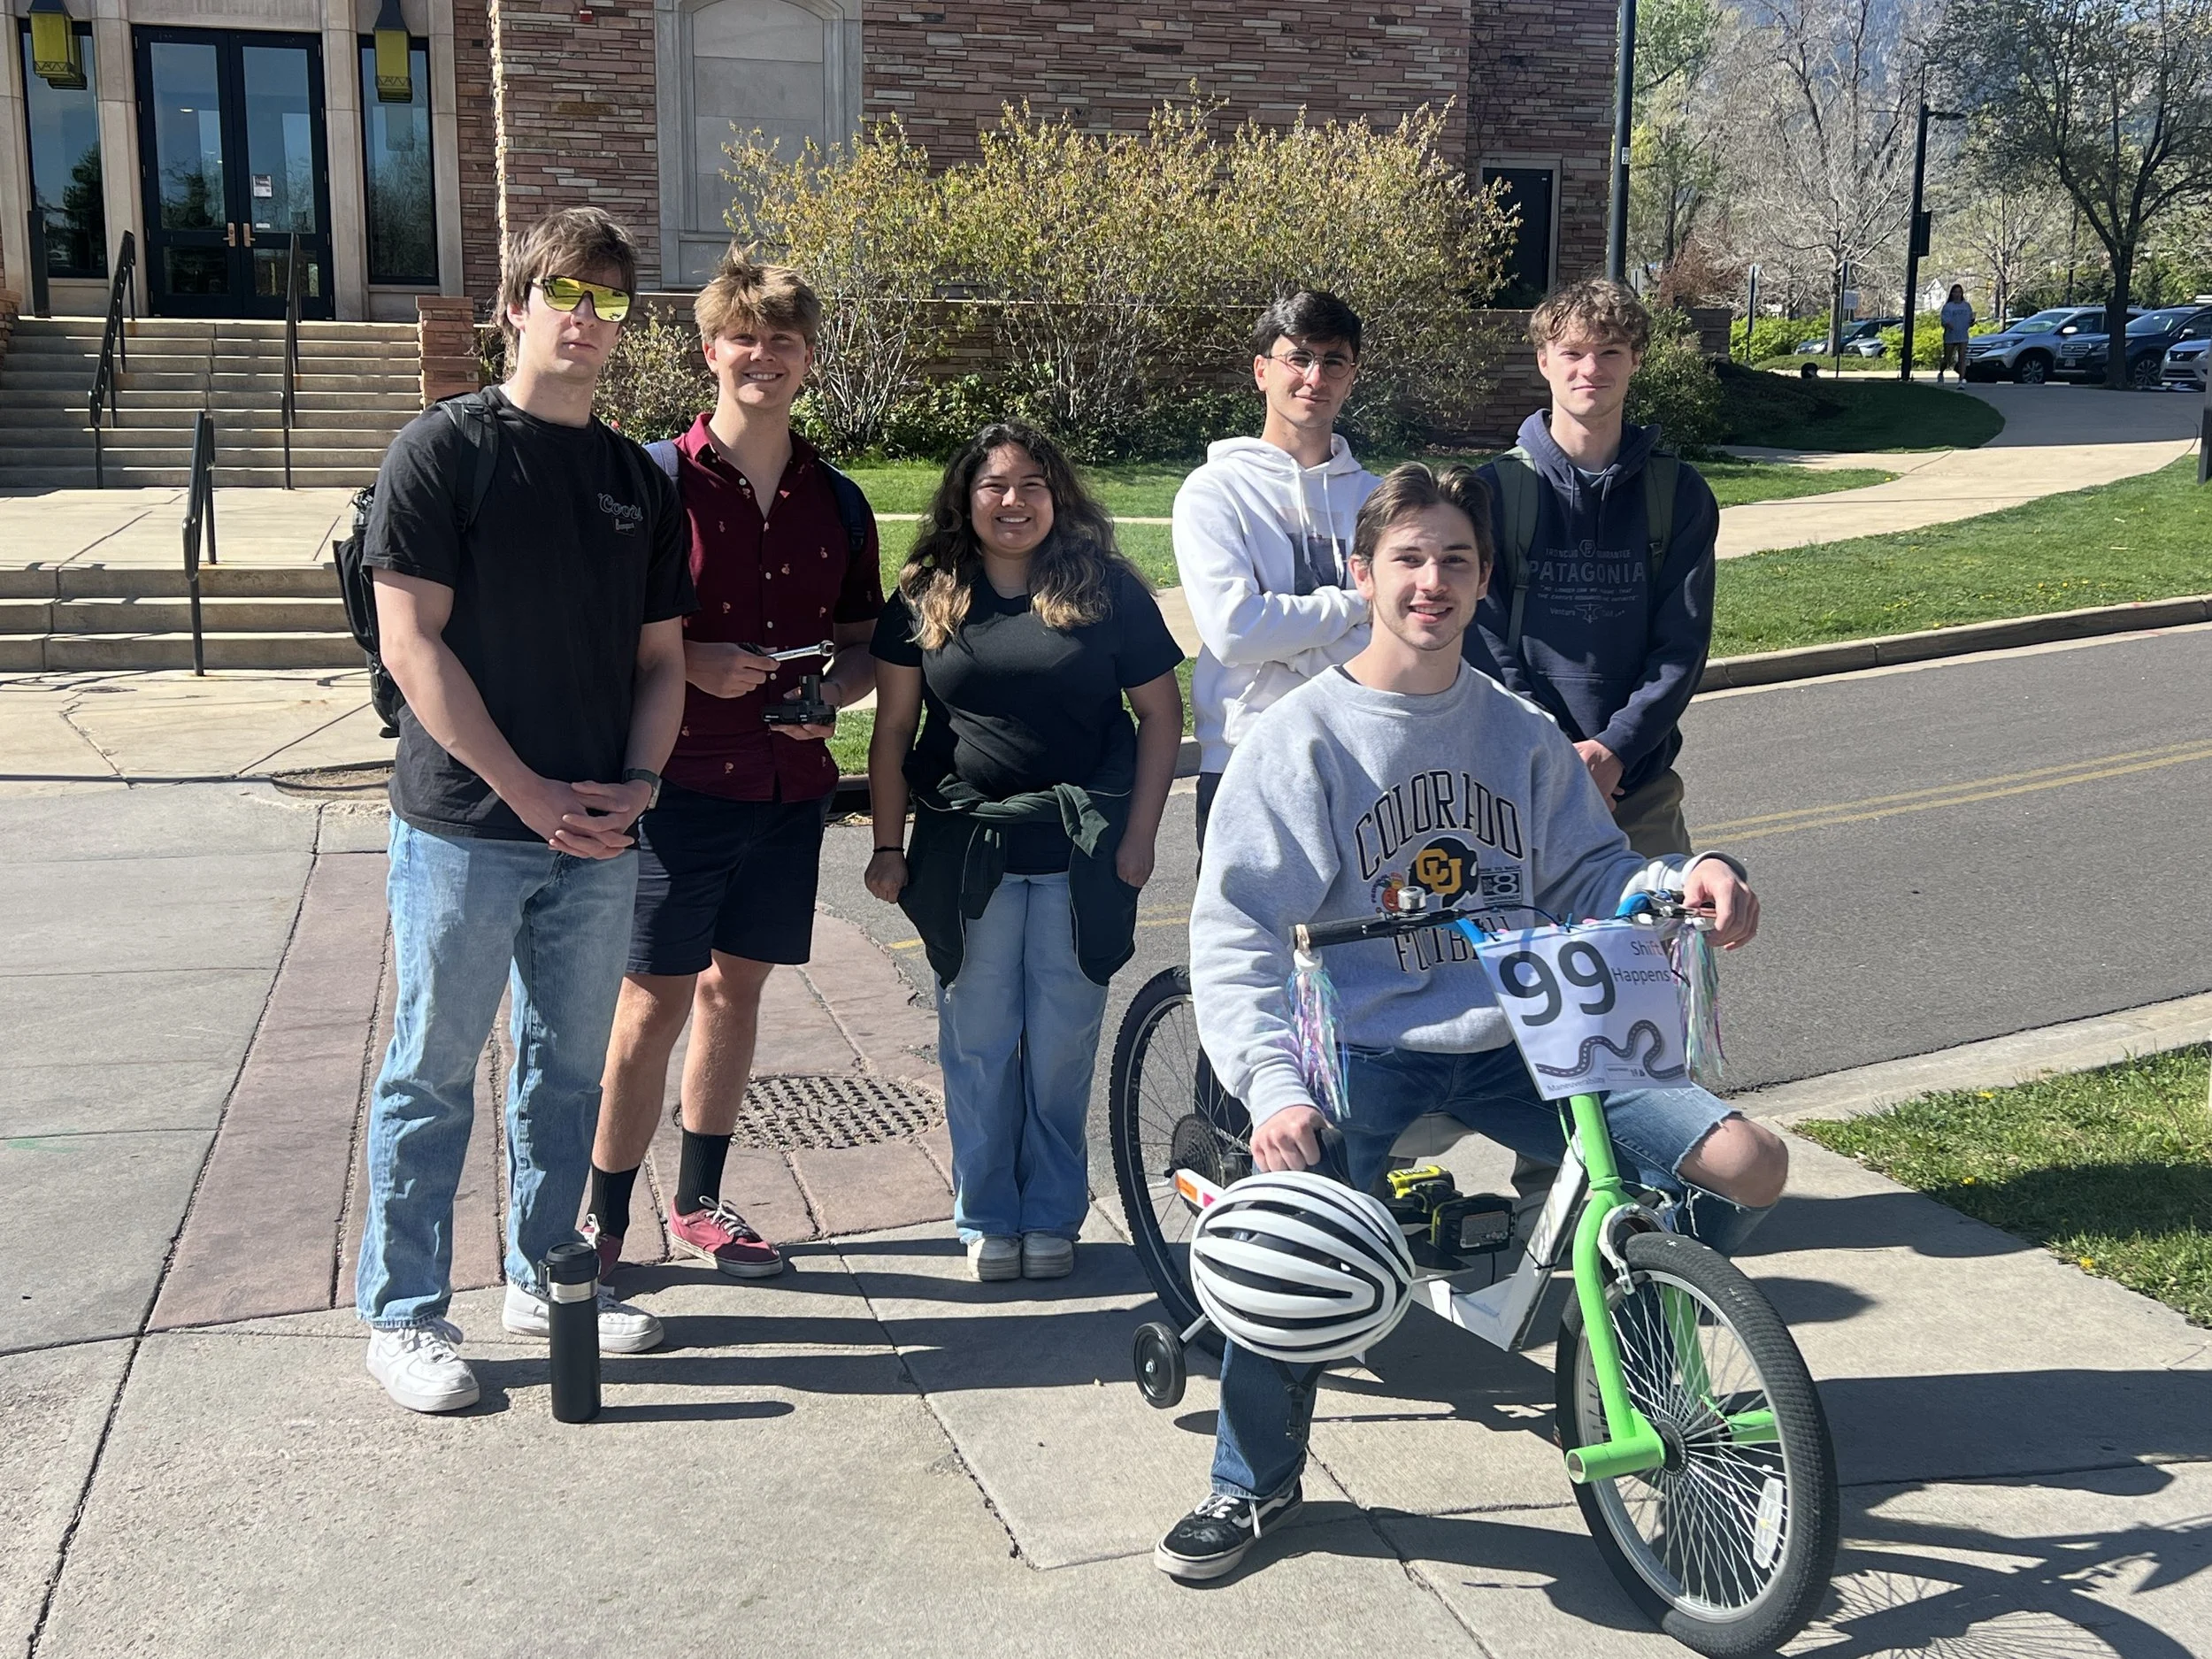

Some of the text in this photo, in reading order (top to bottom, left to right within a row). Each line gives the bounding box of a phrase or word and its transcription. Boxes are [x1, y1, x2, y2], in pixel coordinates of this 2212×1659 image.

[597, 493, 643, 521] Coors
[1528, 560, 1647, 584] PATAGONIA
[1355, 770, 1525, 882] COLORADO
[1493, 873, 1518, 895] 8
[1631, 941, 1663, 956] Shift
[1498, 940, 1616, 1026] 99
[1611, 966, 1671, 986] Happens
